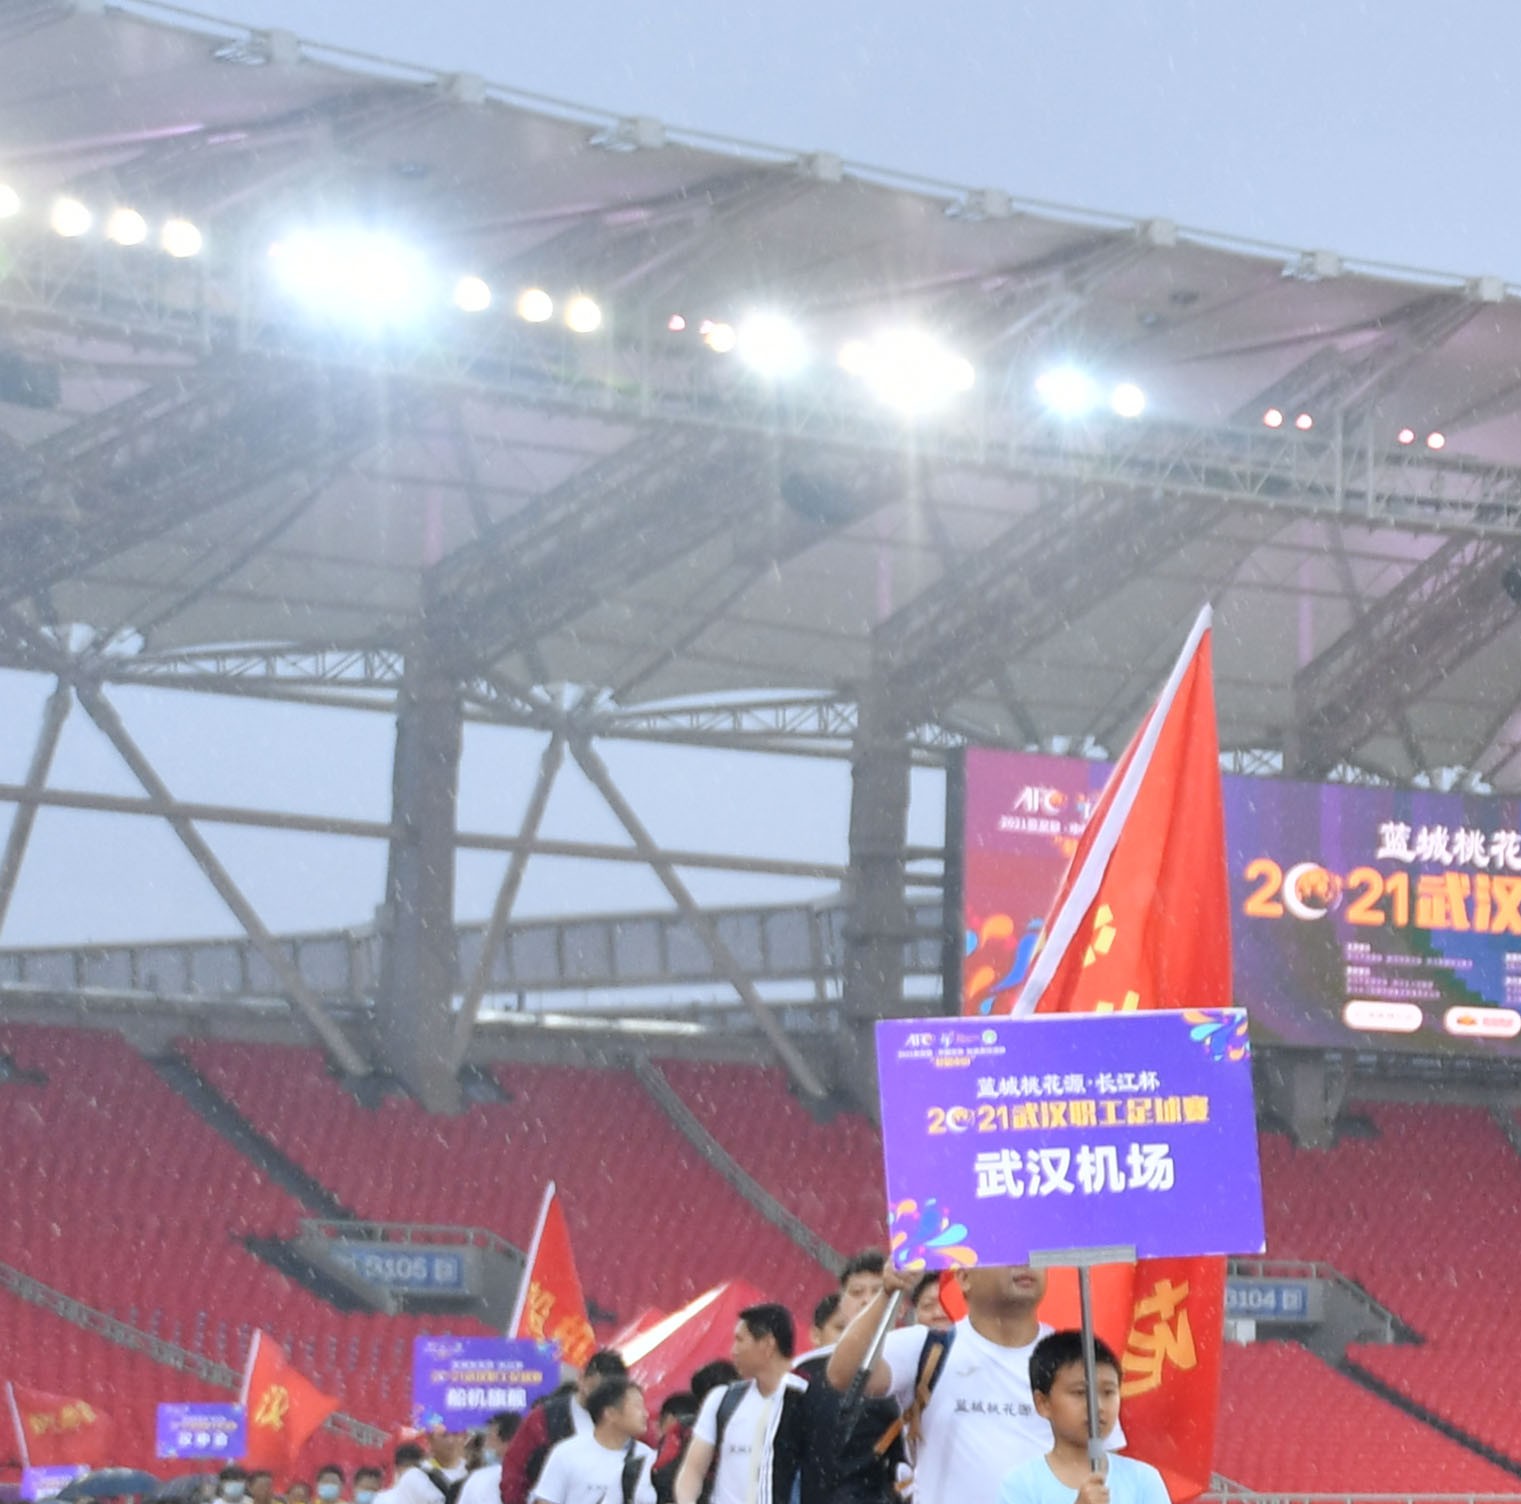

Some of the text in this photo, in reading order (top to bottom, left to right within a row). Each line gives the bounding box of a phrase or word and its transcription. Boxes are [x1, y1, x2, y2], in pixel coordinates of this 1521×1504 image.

[977, 1071, 1160, 1100] 蓝城桃花源·长江杯
[974, 1142, 1176, 1199] 武汉机场
